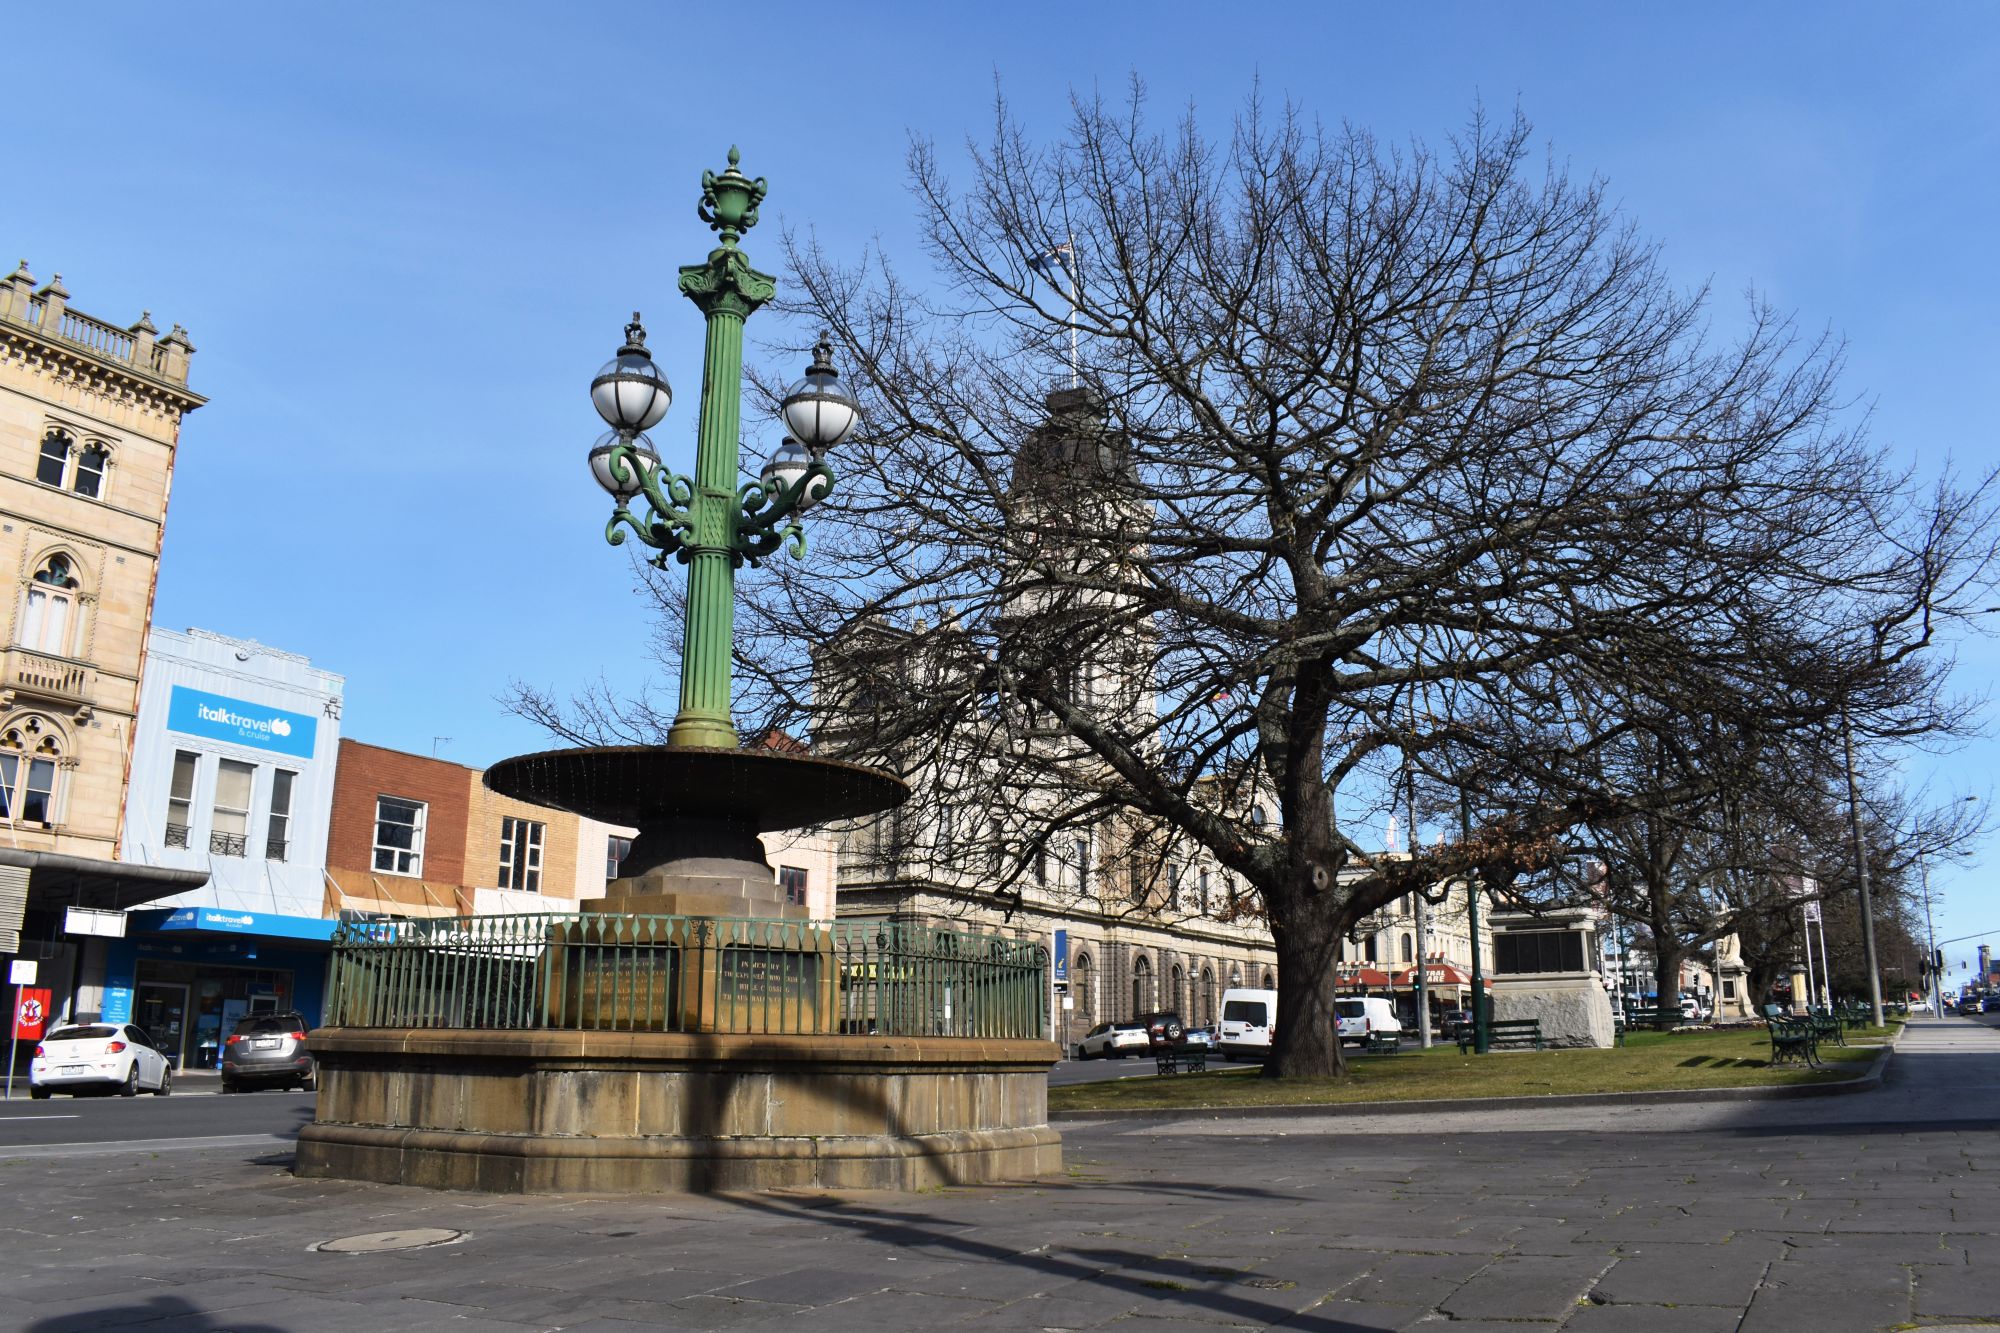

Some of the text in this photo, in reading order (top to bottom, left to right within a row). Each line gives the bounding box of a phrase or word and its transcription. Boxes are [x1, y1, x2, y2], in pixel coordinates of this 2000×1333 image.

[198, 703, 272, 733] italktravel
[238, 728, 271, 741] & cruise
[1408, 975, 1445, 983] SARE
